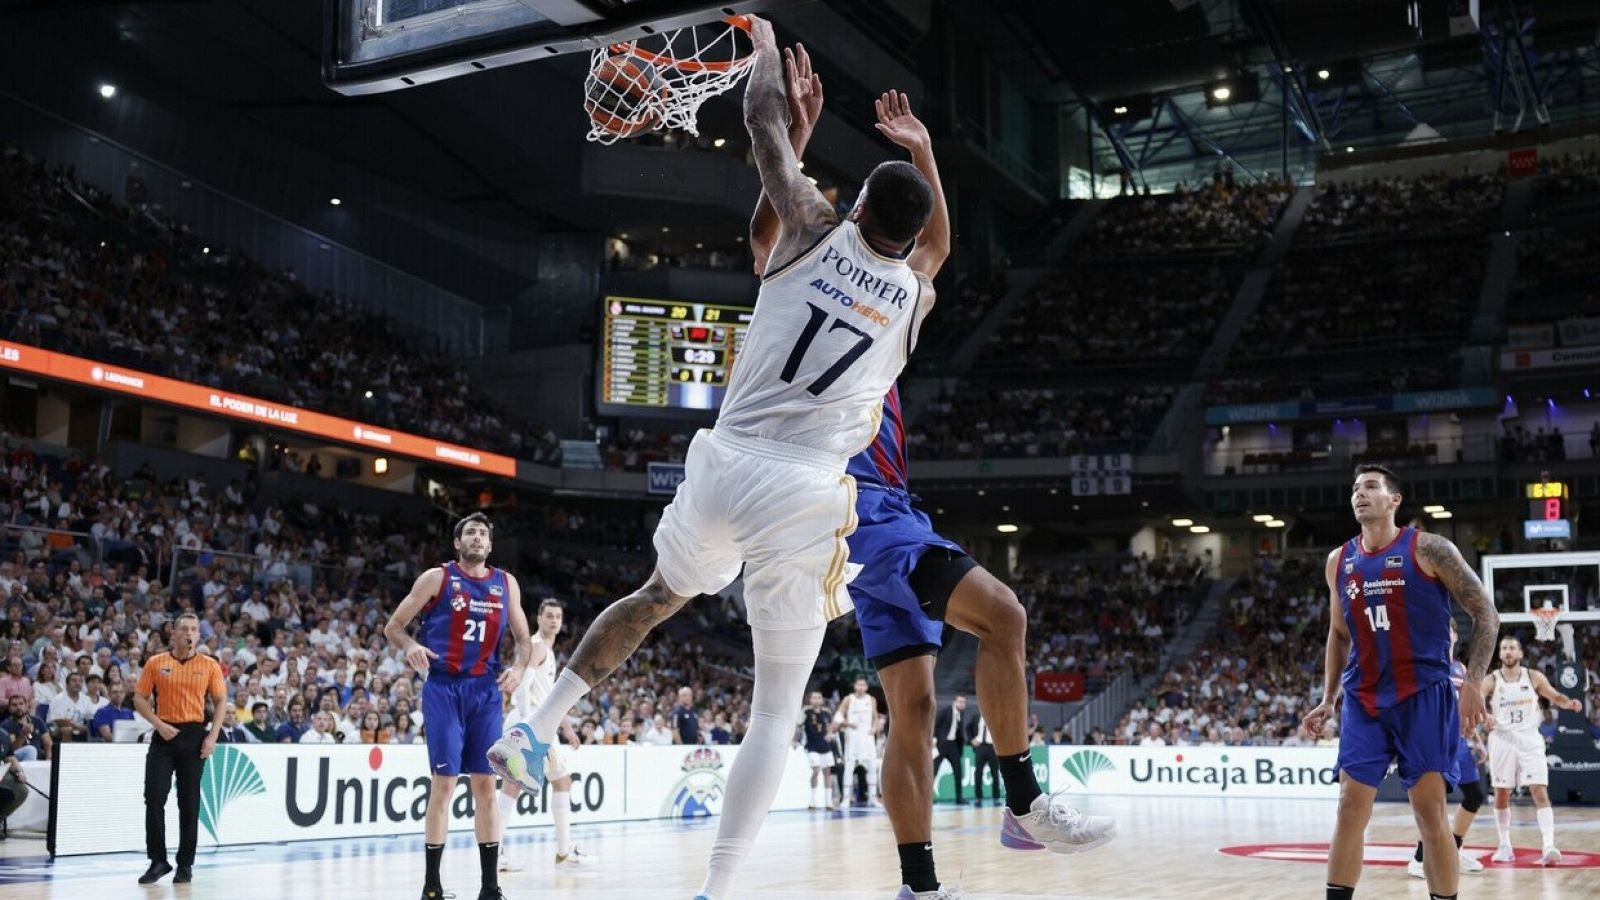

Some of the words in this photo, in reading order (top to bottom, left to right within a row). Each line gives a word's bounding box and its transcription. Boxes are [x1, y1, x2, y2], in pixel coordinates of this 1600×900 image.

[821, 245, 908, 310] POIRIER
[809, 277, 890, 328] AUTOHERO
[779, 301, 874, 397] 17
[209, 394, 222, 408] EL
[462, 619, 487, 643] 21
[1364, 604, 1391, 632] 14
[286, 746, 475, 828] Unicaa
[1130, 754, 1248, 791] Unicaja
[1255, 758, 1335, 786] Banc
